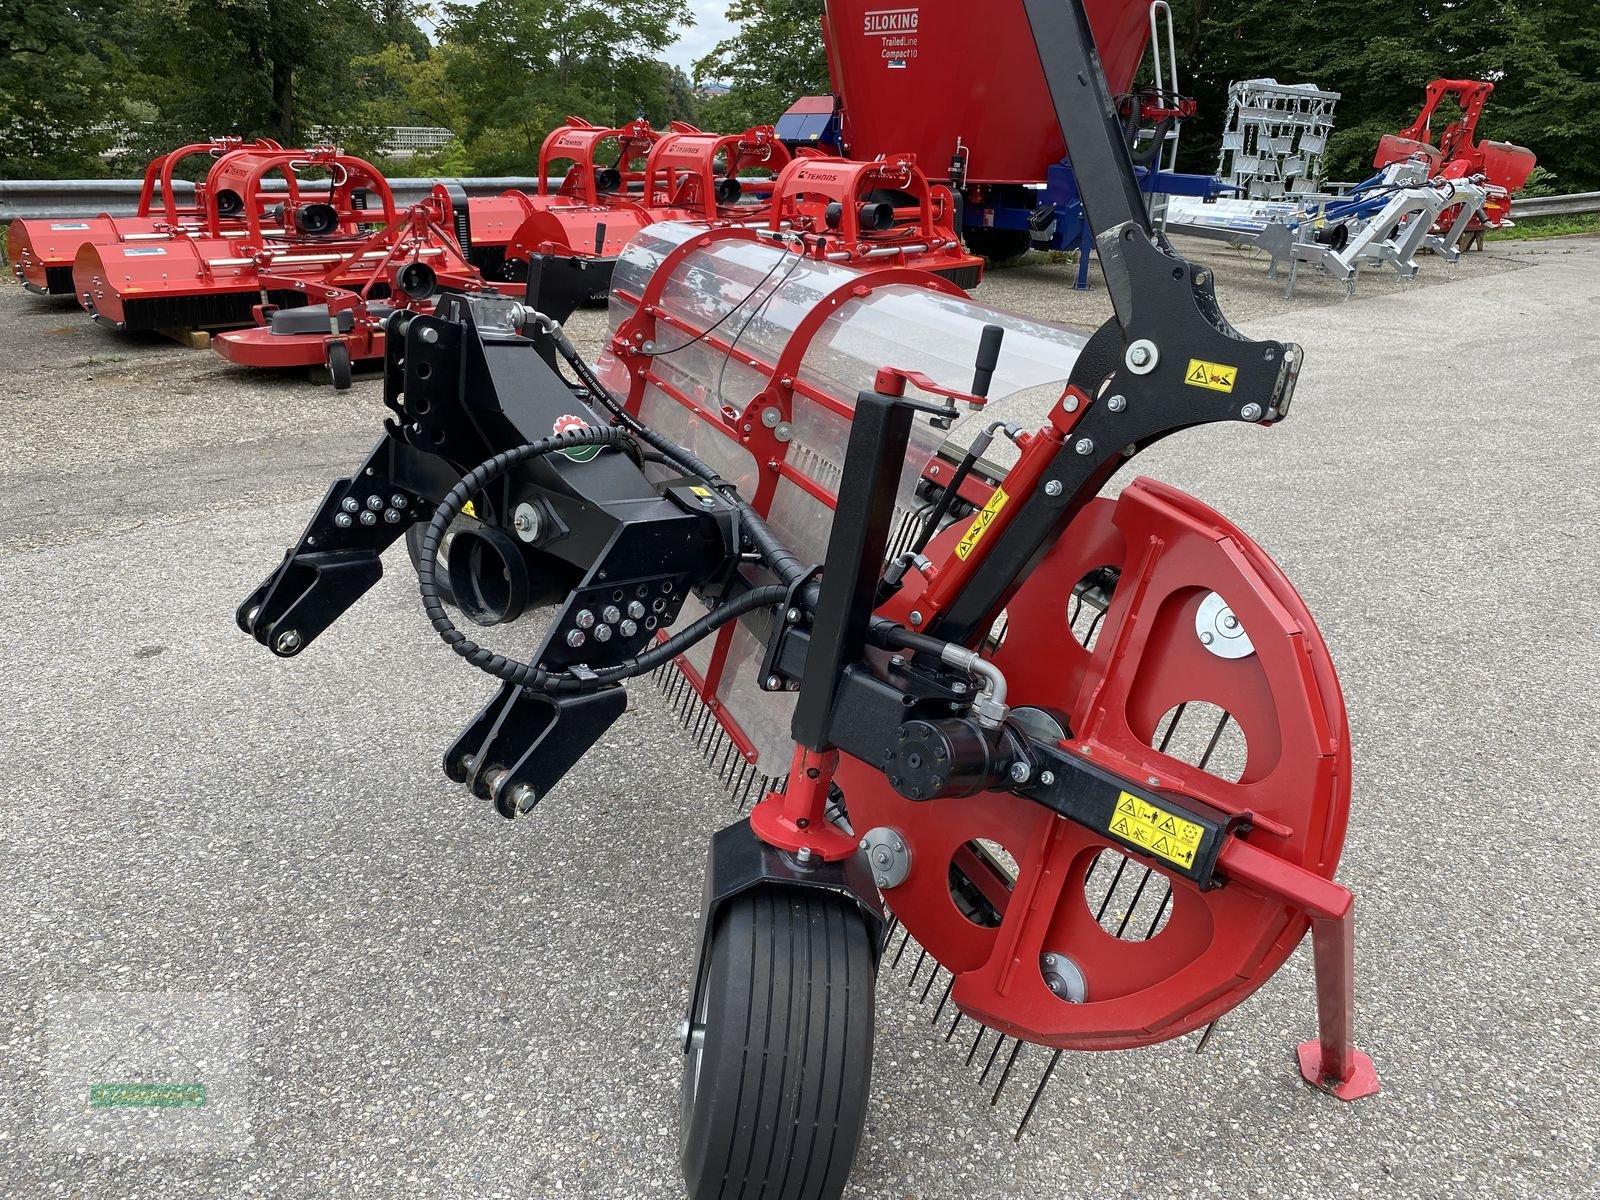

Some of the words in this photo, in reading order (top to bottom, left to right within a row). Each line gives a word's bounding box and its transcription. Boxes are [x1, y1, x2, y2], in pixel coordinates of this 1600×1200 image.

[864, 14, 918, 30] SILOKING
[882, 37, 917, 46] TrailedLine
[807, 173, 838, 181] TEHNOS
